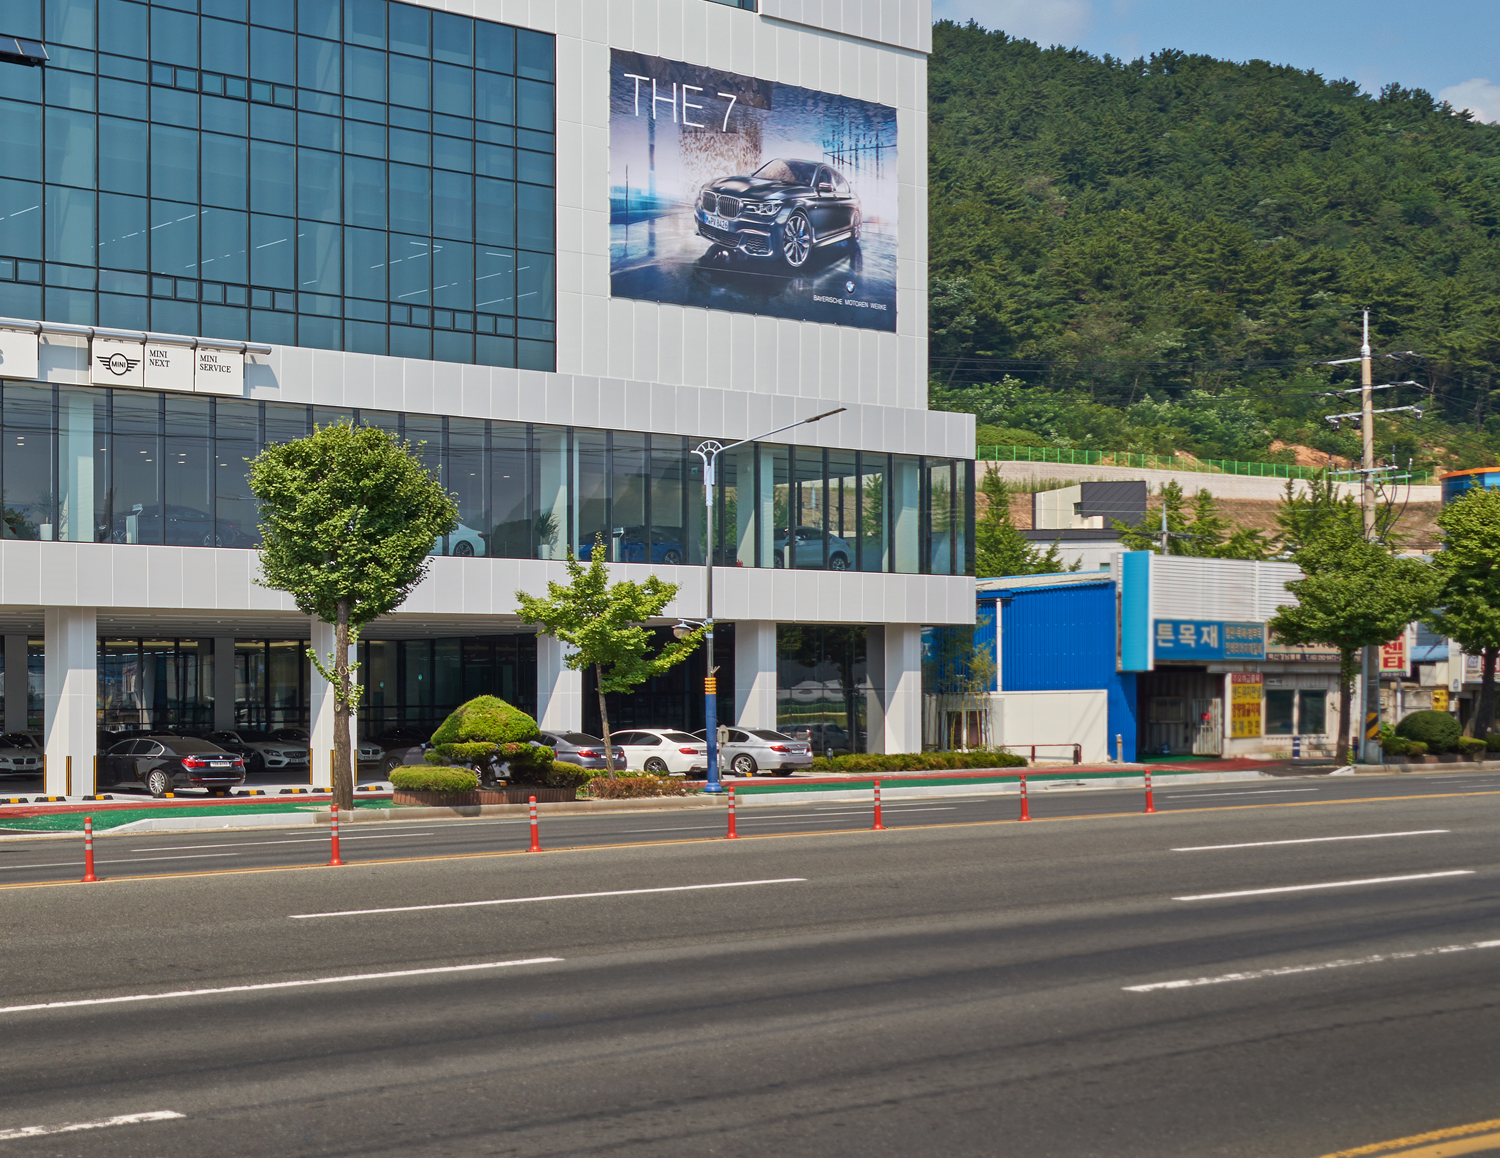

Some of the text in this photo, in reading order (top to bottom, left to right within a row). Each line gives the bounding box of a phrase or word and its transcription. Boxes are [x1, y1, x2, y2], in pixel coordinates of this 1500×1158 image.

[623, 73, 737, 132] THE 7
[813, 294, 887, 311] BAYERISCHE MOTOREN WERKE
[149, 349, 168, 359] MINI
[199, 354, 218, 363] MINI
[149, 358, 171, 368] NEXT
[199, 363, 231, 373] SERVICE
[1155, 623, 1219, 649] 튼목재
